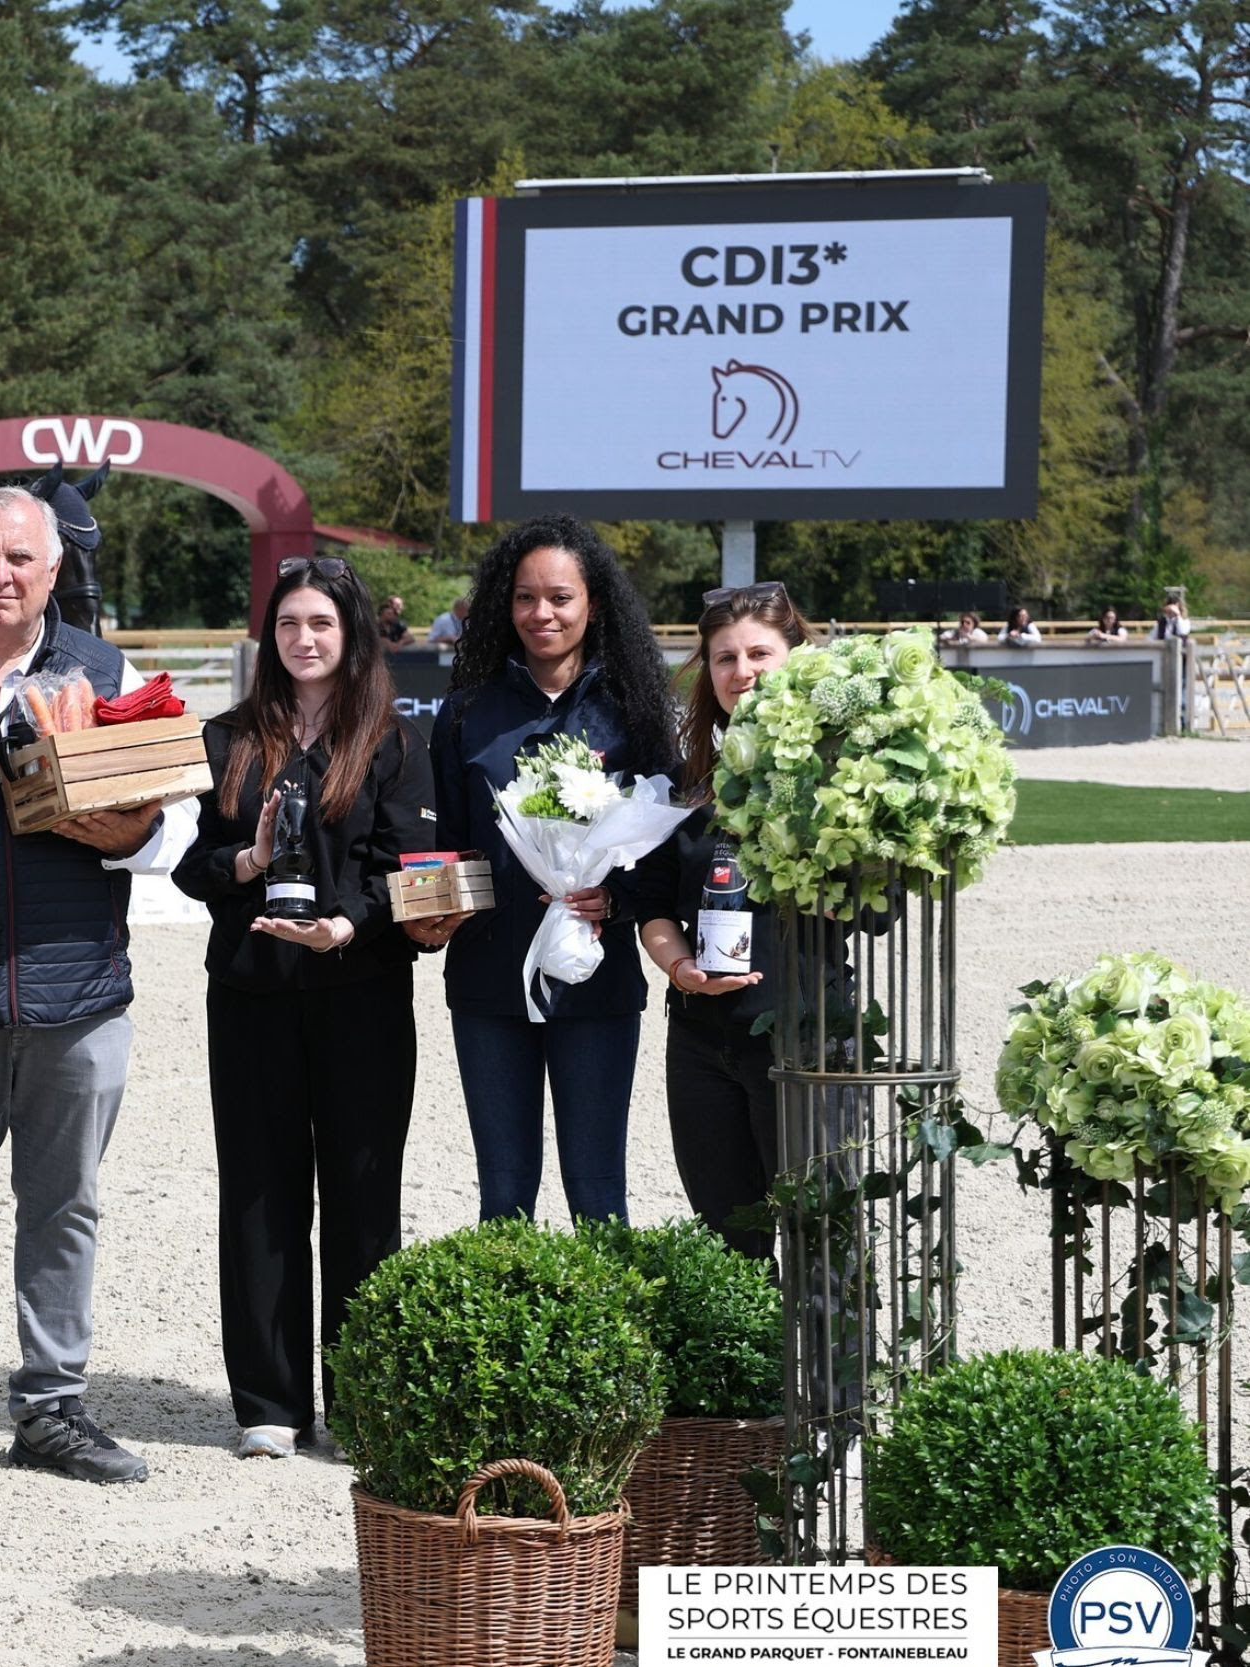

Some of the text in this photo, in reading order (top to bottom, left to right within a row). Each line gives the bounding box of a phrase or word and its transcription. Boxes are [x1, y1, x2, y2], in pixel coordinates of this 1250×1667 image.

[617, 300, 910, 336] GRAND PRIX
[21, 418, 143, 465] CWD
